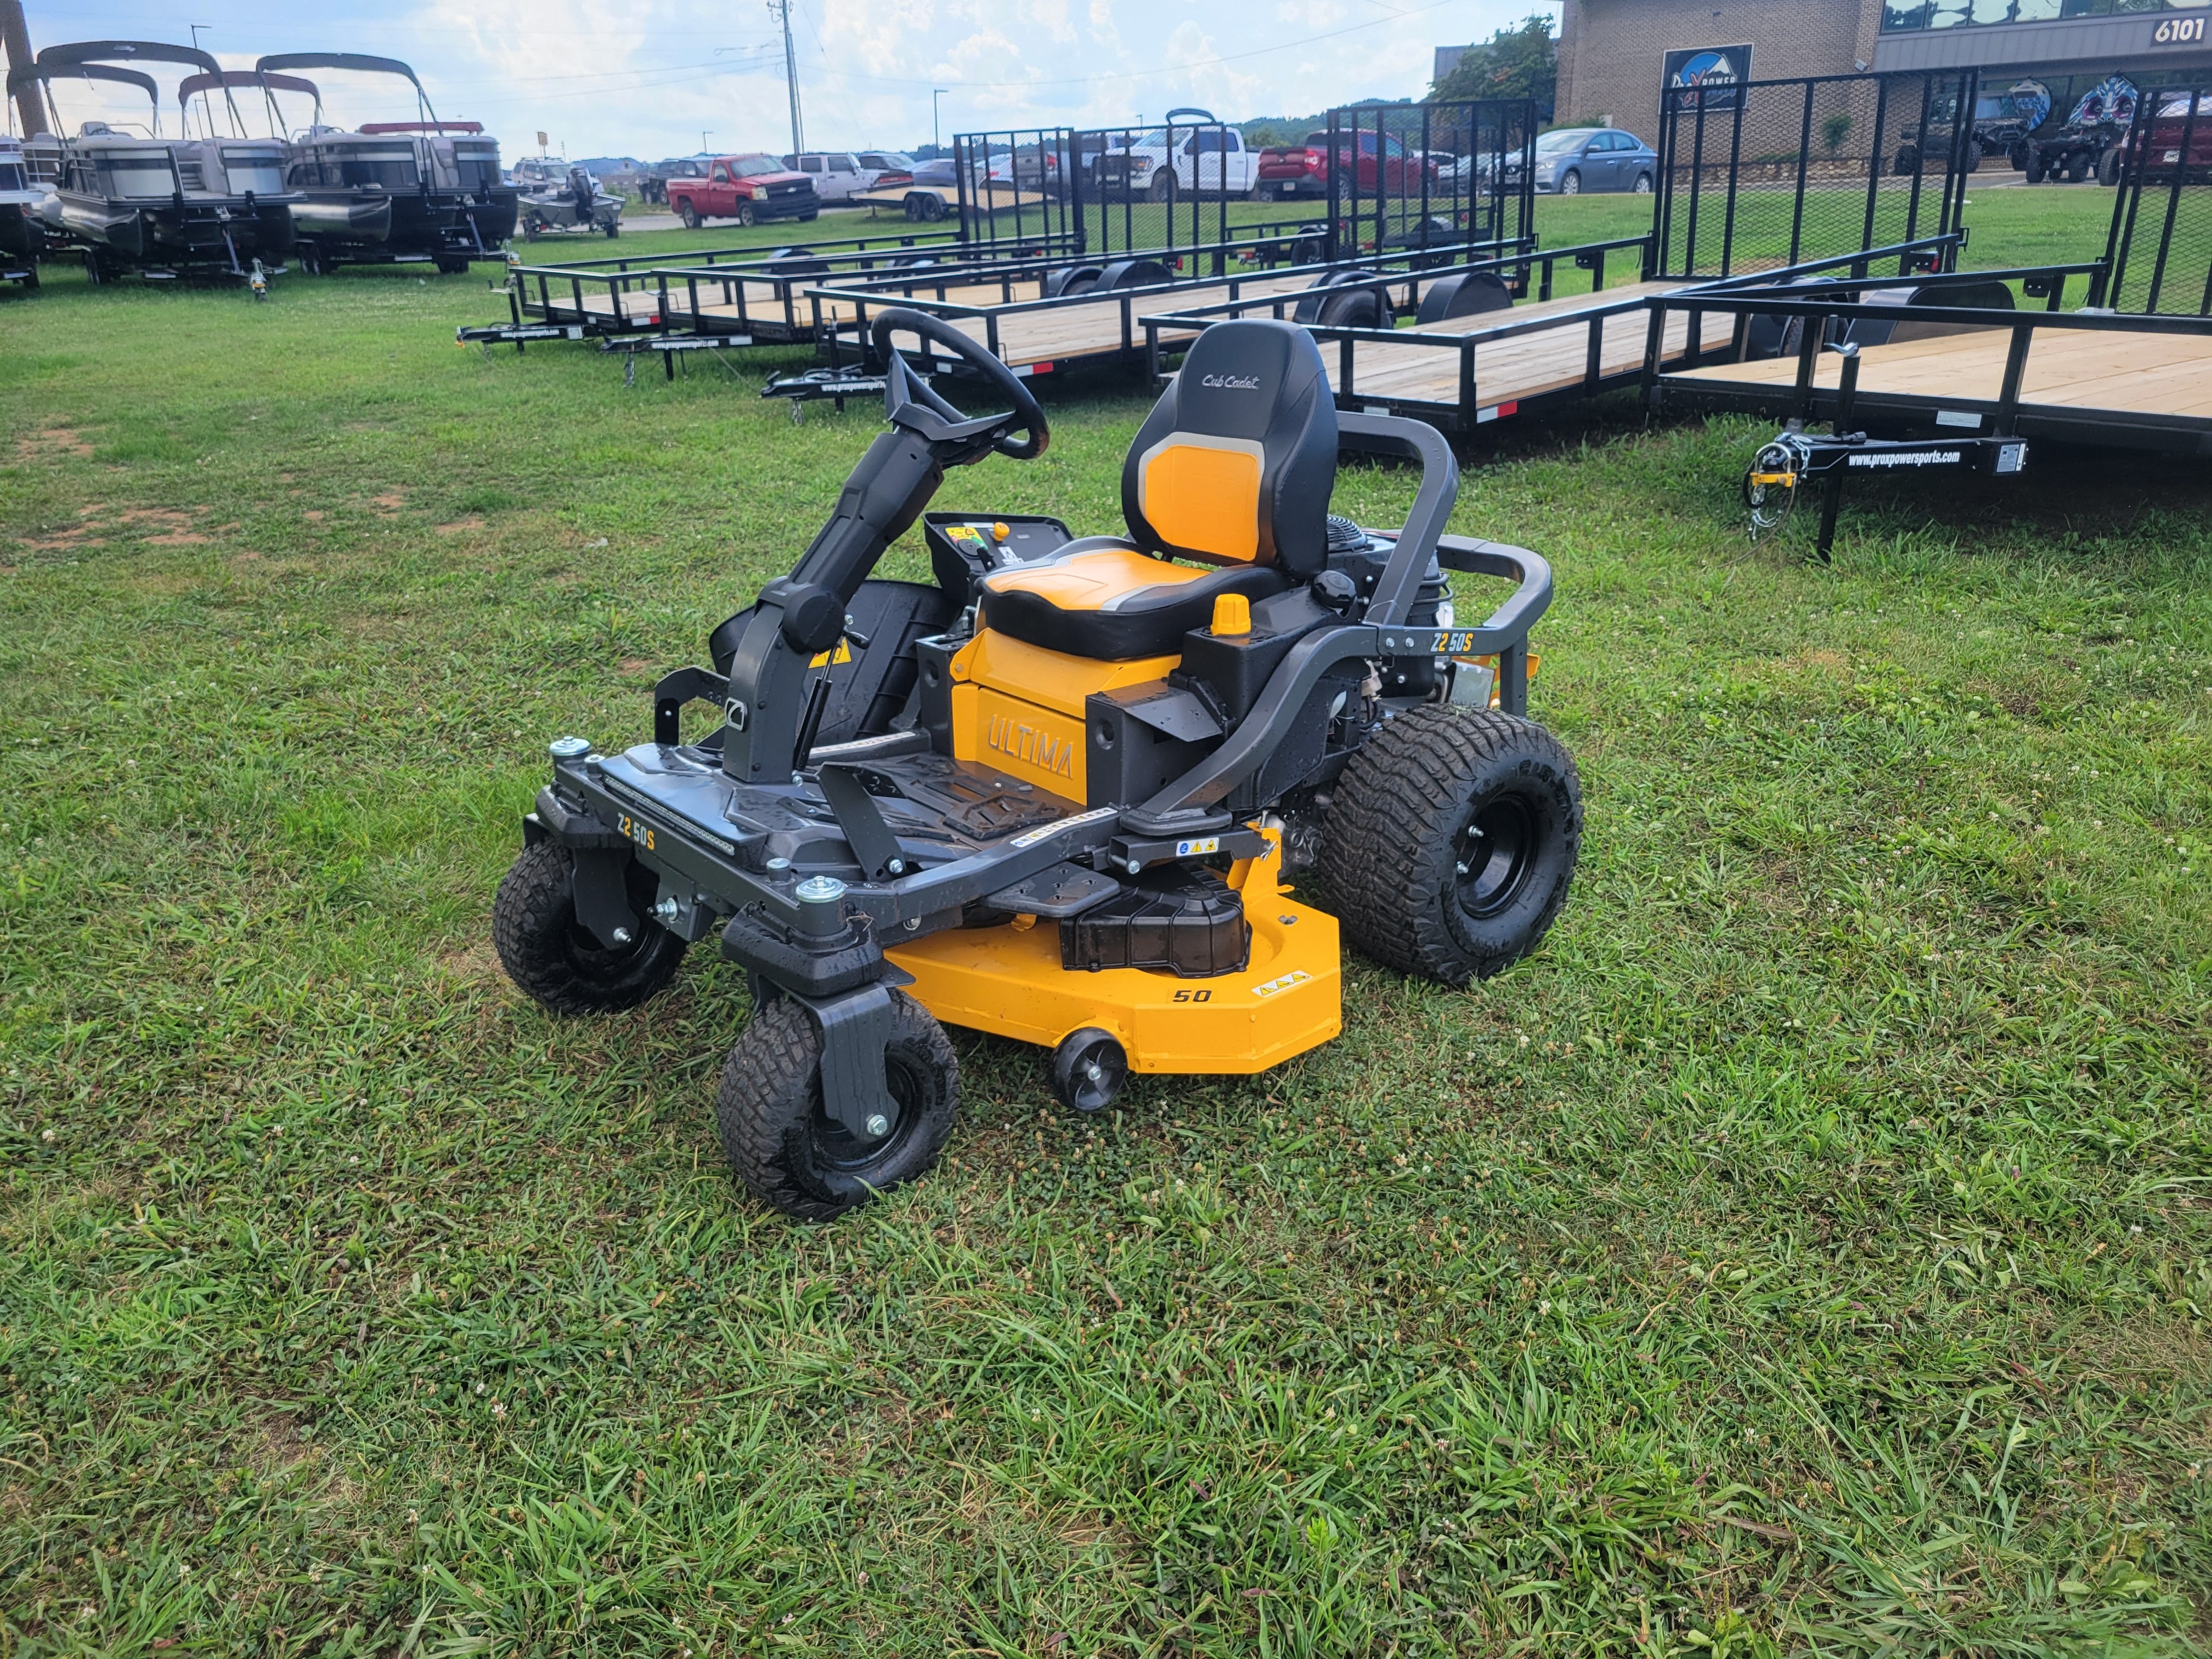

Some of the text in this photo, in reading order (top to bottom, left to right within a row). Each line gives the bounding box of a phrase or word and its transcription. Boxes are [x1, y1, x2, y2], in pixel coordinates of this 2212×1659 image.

[2155, 18, 2204, 42] 6101
[1202, 374, 1260, 390] Cub Cadet
[1849, 449, 1960, 468] www.proxpowersports.com
[1430, 633, 1474, 652] Z2 50S
[989, 714, 1074, 780] ULTIMA
[617, 812, 654, 850] Z2 50S
[1172, 990, 1212, 1002] 50
